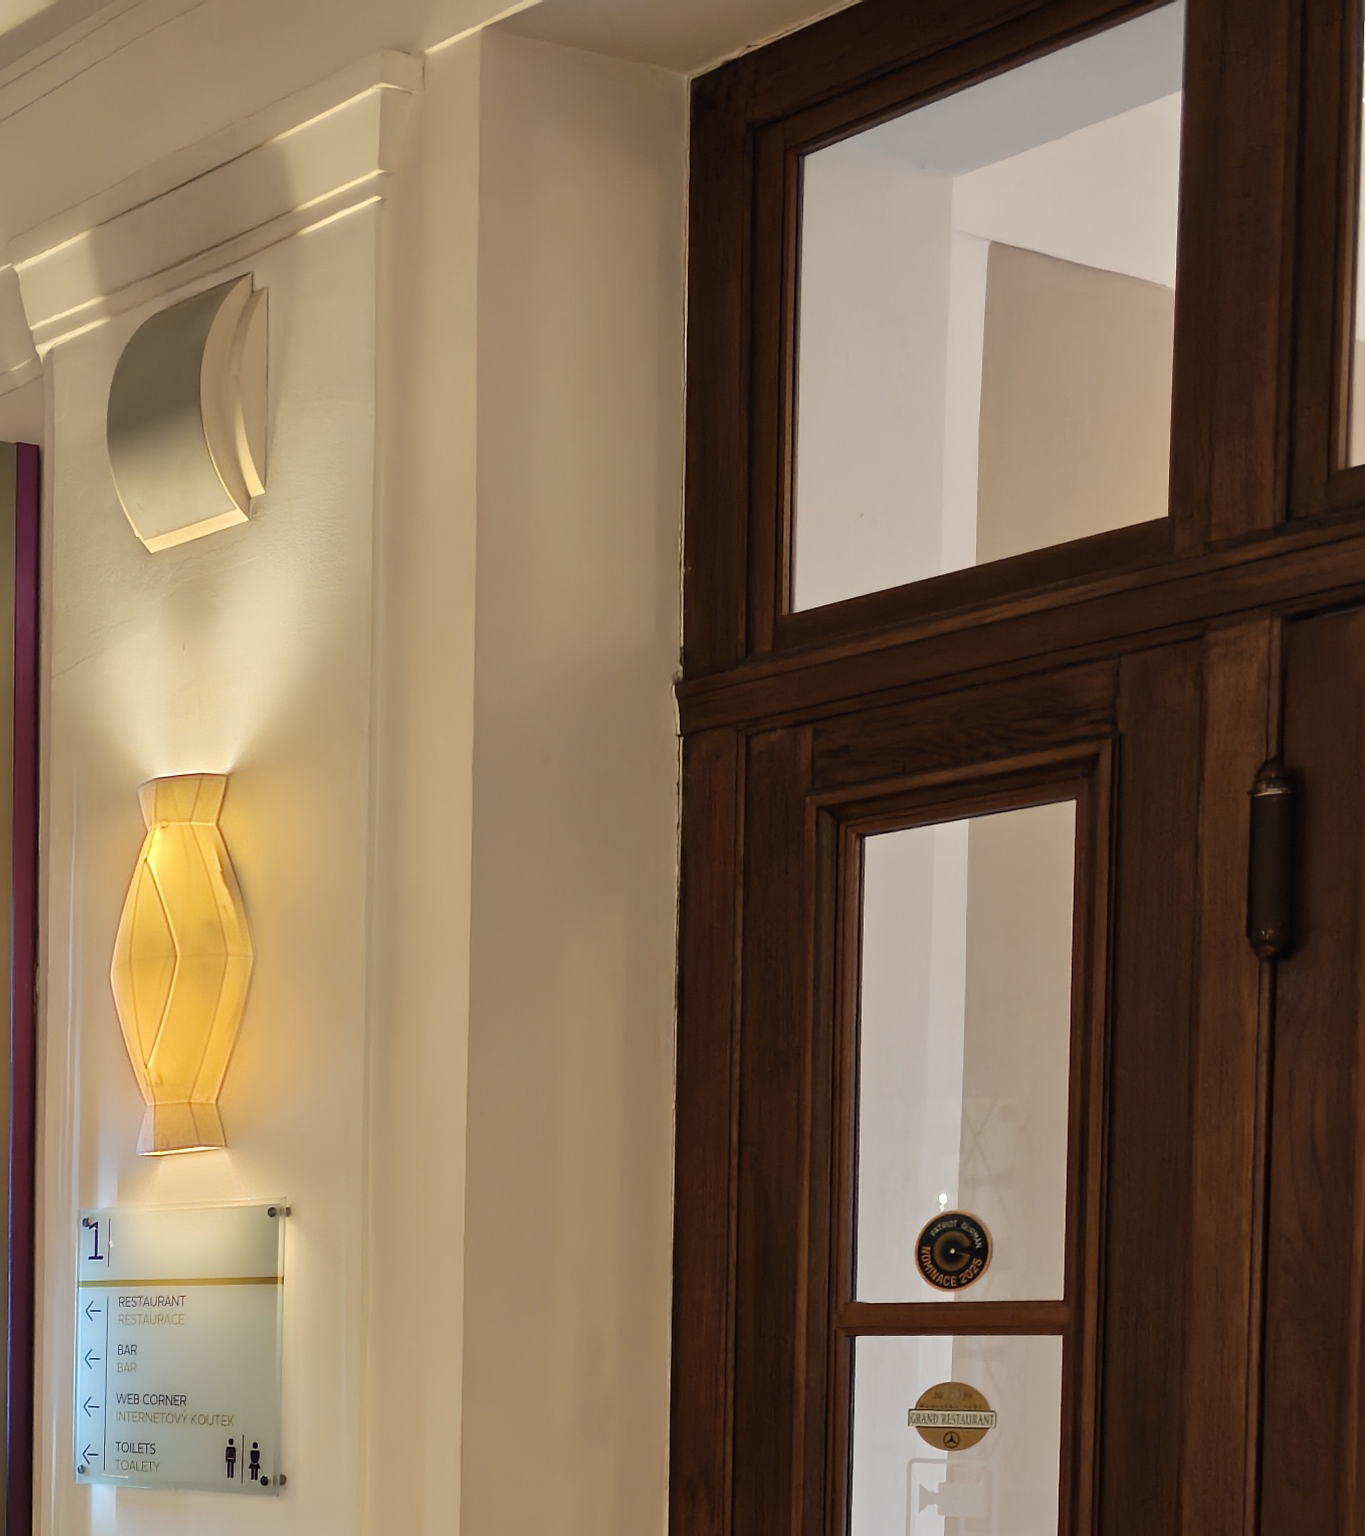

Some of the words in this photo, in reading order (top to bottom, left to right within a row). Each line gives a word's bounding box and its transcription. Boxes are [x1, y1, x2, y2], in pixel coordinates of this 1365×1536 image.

[88, 1221, 104, 1261] 1
[921, 1246, 957, 1287] NOMINACE
[118, 1295, 186, 1308] RESTAURANT
[118, 1313, 185, 1326] RESTAURACE
[117, 1344, 138, 1356] BAR
[116, 1362, 137, 1374] BAR
[116, 1393, 140, 1405] WEB
[142, 1393, 187, 1407] CORNER
[190, 1414, 235, 1427] KOUTEK
[910, 1412, 939, 1425] GRAND
[941, 1413, 994, 1426] RESTAURANT
[115, 1441, 156, 1455] TOILETS
[115, 1459, 160, 1473] TOALETY
